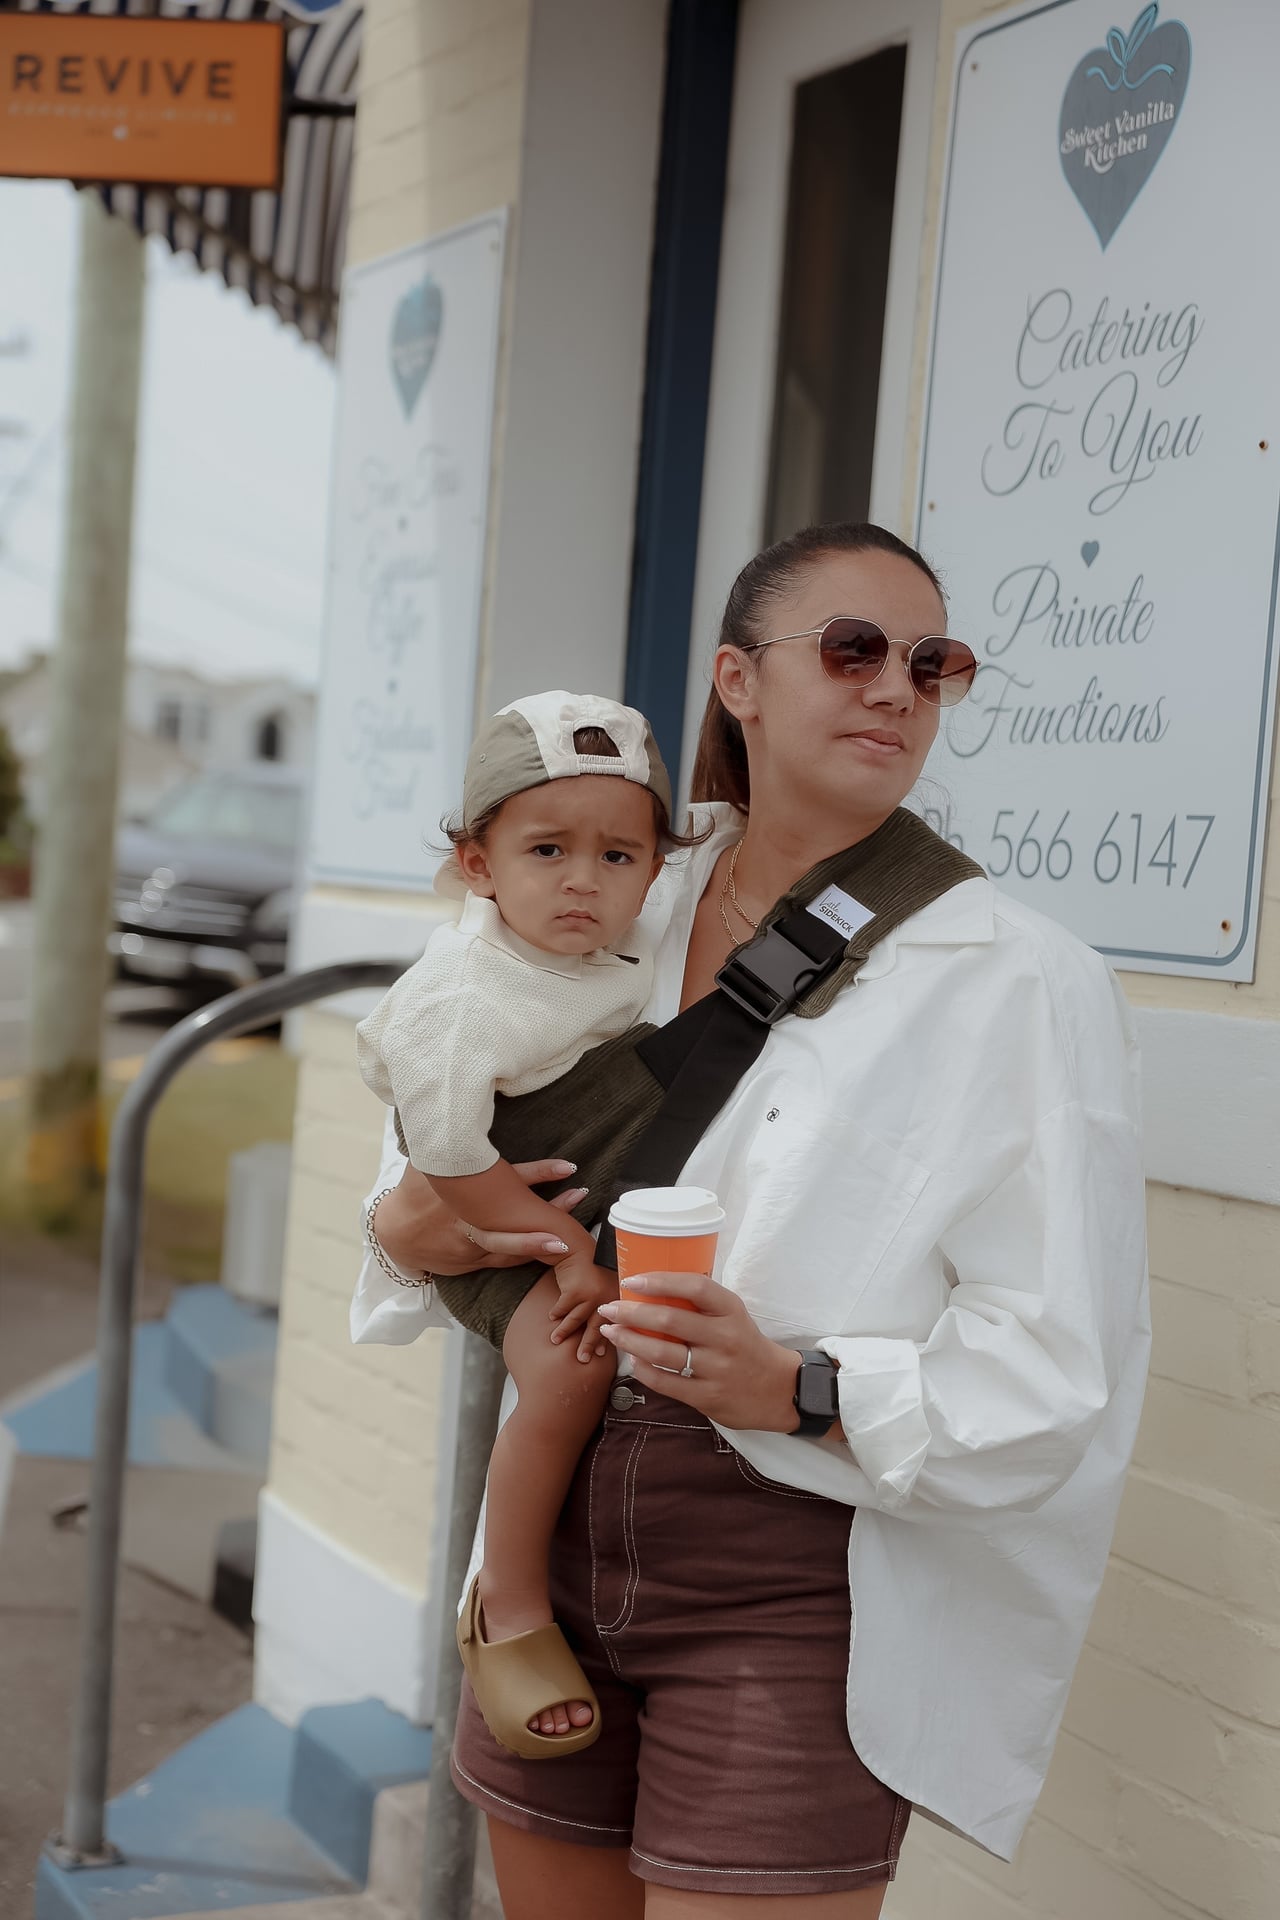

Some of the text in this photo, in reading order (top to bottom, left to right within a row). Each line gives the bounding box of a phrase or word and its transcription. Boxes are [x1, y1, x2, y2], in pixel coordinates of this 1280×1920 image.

[12, 54, 236, 100] REVIVE
[1061, 100, 1175, 154] Sweet Vanilla
[1084, 132, 1148, 174] Kitchen
[1016, 287, 1204, 390] Catering
[981, 370, 1203, 515] To You
[985, 560, 1155, 656] Private
[946, 664, 1170, 758] Functions
[987, 809, 1073, 880] 566
[1093, 810, 1216, 889] 6147
[818, 905, 854, 933] SIDEKICK
